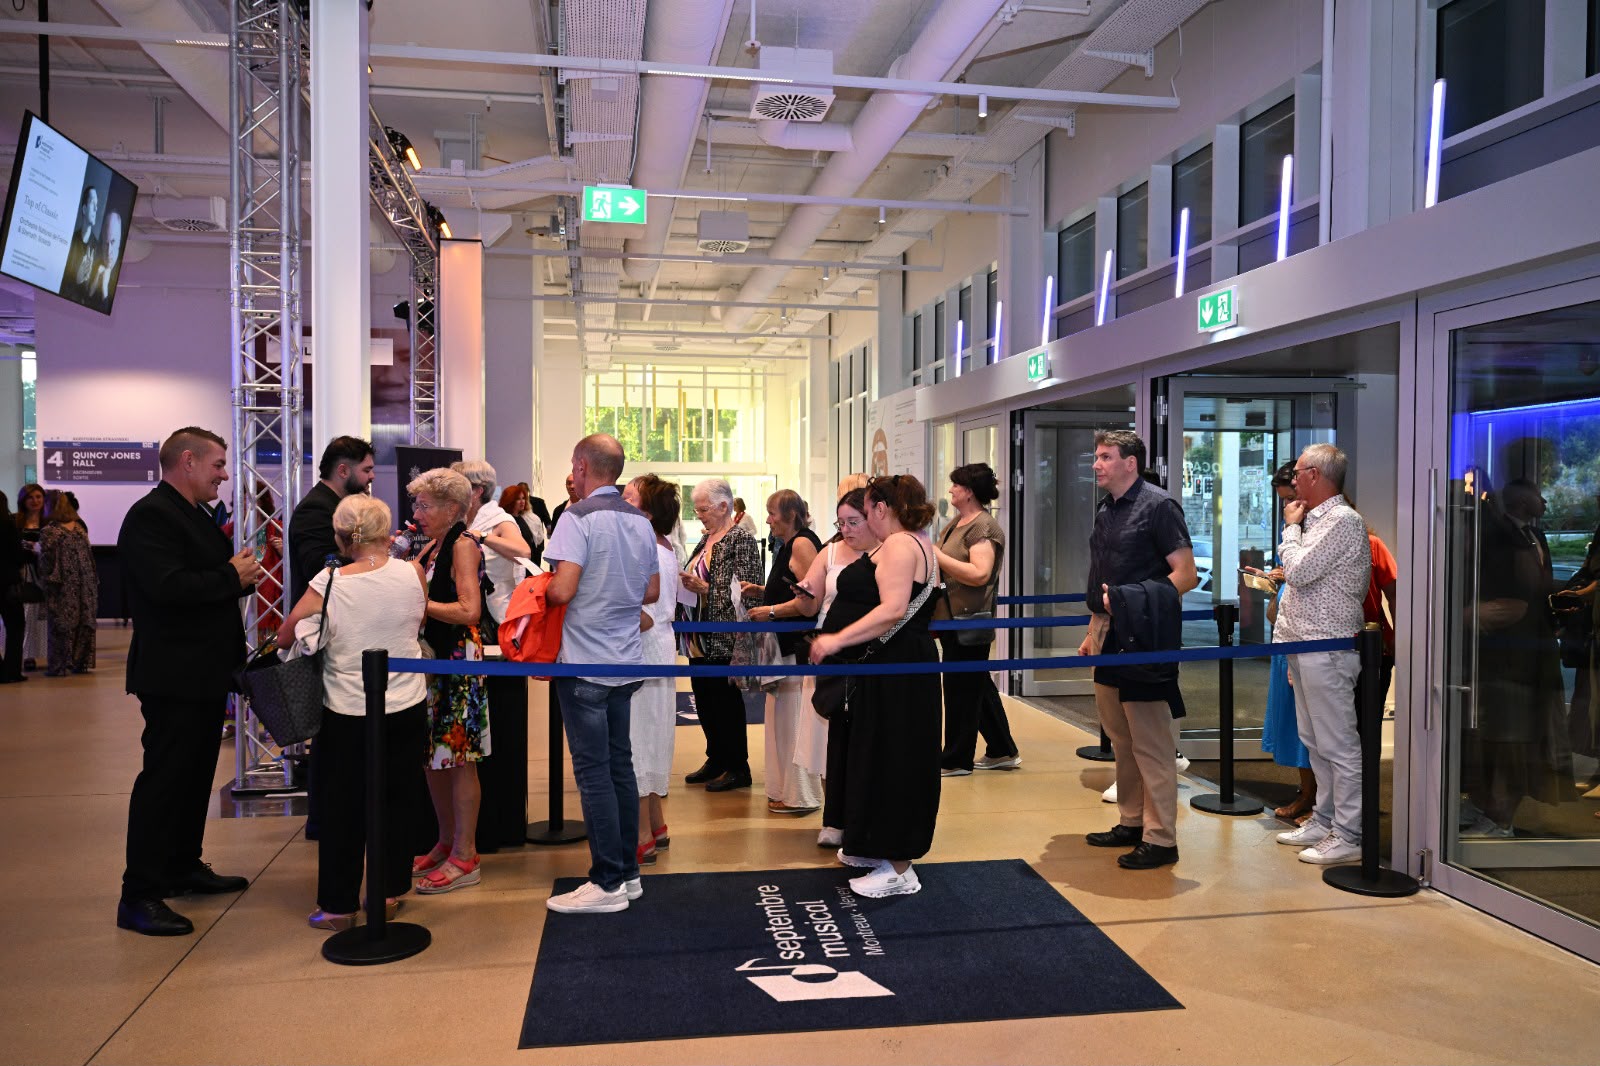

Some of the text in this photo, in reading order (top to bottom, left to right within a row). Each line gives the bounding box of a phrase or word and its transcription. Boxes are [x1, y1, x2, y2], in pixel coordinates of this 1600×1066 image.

[47, 451, 64, 467] 4
[72, 452, 141, 460] QUINCY JONES
[755, 884, 806, 960] septembre
[796, 899, 851, 958] musical
[849, 913, 886, 957] Montreux
